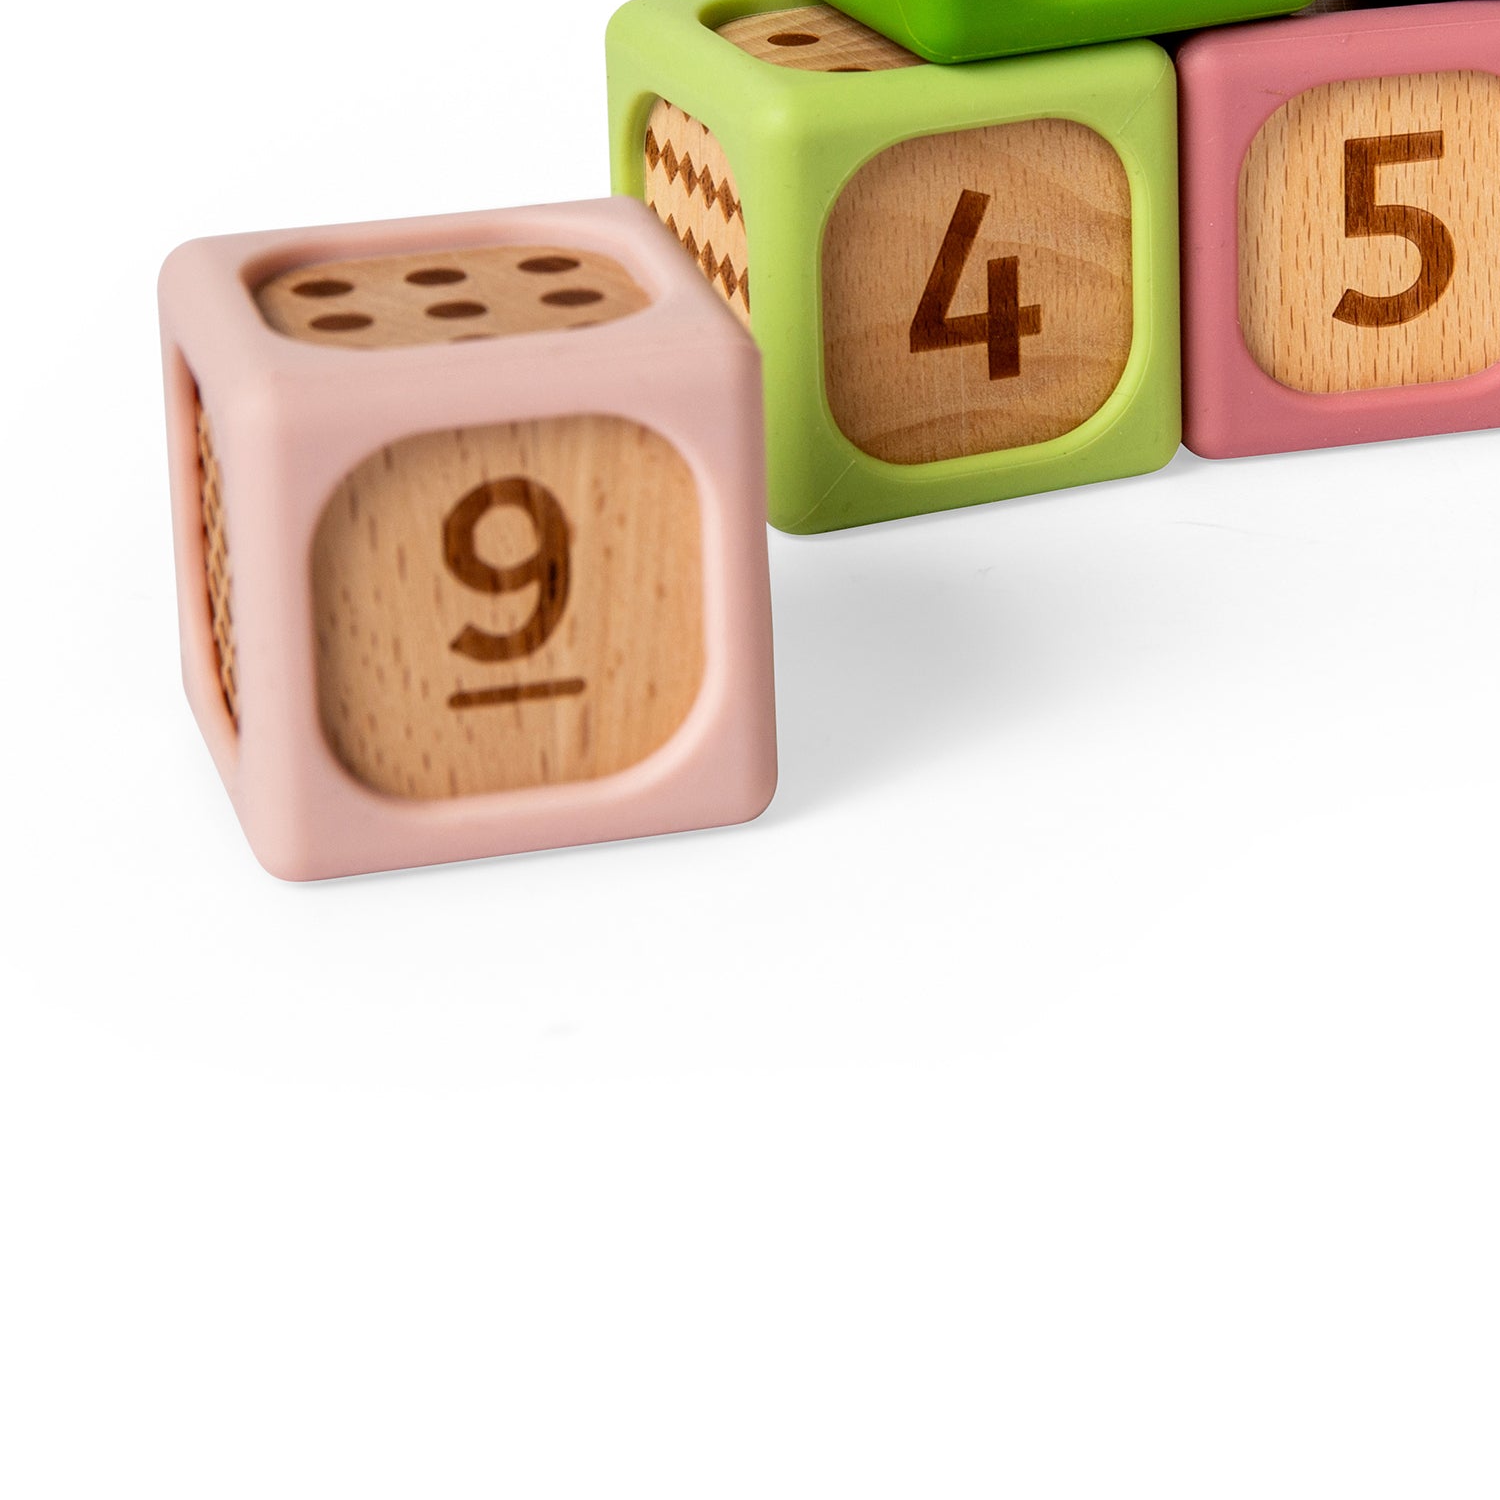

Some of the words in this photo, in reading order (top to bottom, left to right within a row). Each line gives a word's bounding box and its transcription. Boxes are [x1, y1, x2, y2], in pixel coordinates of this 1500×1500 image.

[909, 190, 1041, 381] 4
[1332, 130, 1454, 328] 5
[443, 476, 573, 662] 9
